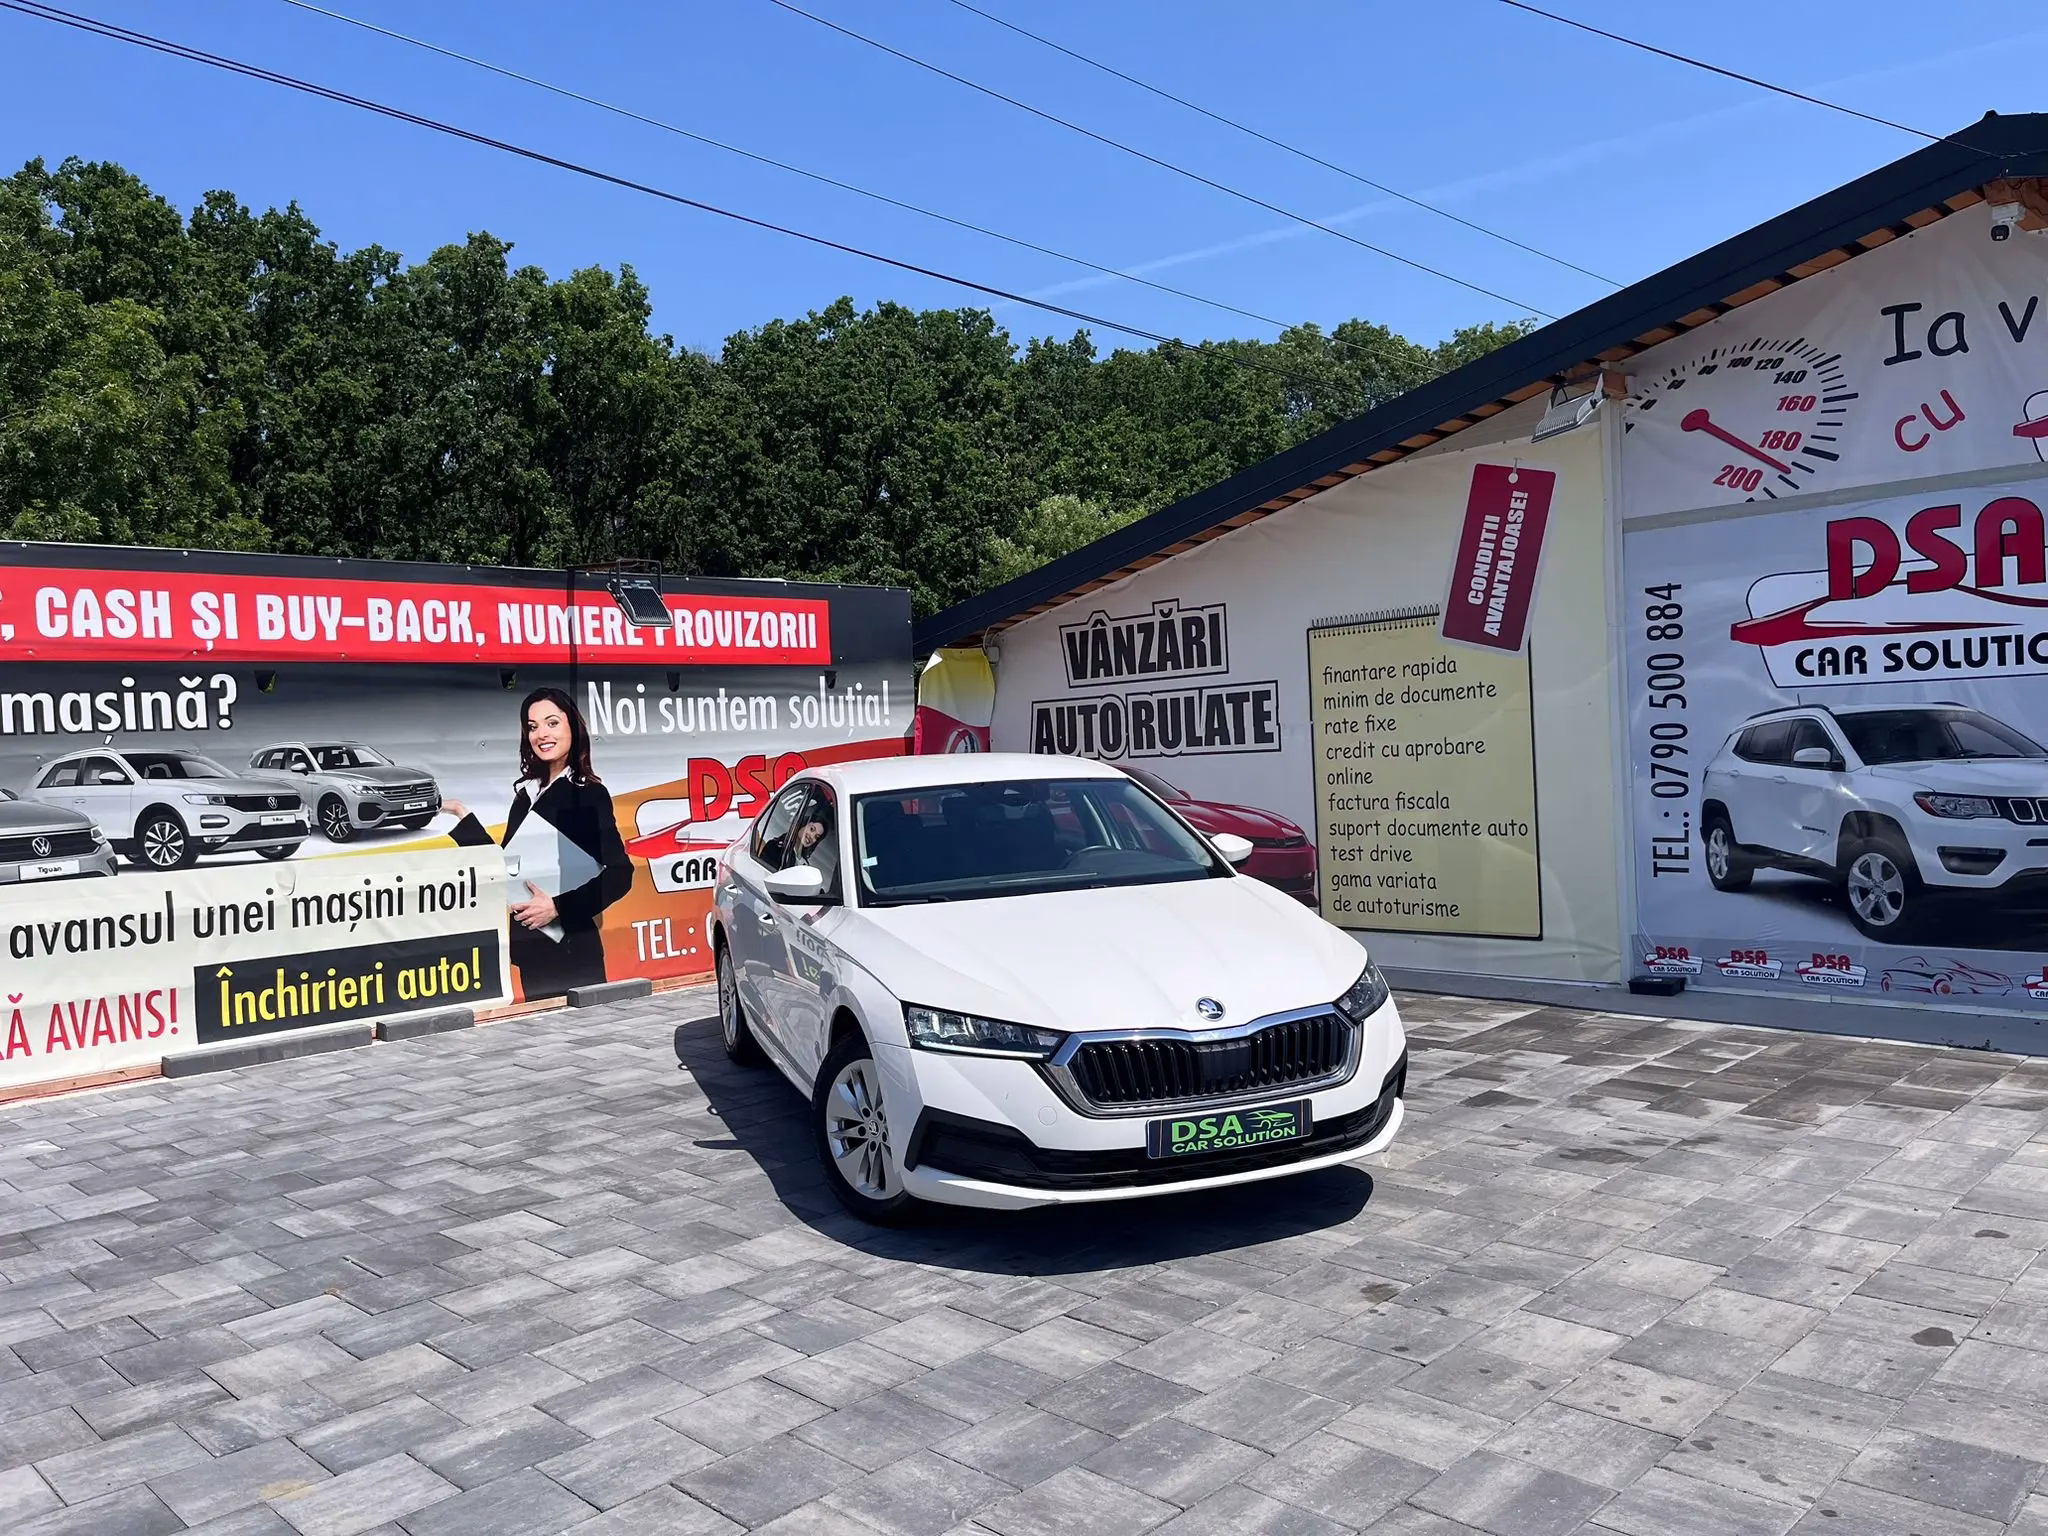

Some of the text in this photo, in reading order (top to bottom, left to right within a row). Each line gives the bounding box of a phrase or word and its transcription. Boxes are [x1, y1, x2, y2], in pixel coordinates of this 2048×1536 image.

[1880, 302, 1969, 366] Ia
[1727, 356, 1753, 368] 100
[1754, 357, 1784, 370] 120
[1773, 370, 1807, 384] 140
[1777, 395, 1816, 412] 160
[1894, 389, 1966, 452] cu
[1759, 430, 1802, 451] 180
[1712, 465, 1763, 492] 200
[1468, 515, 1500, 605] CONDITII
[1827, 497, 2046, 600] DSA
[1483, 491, 1528, 637] AVANTAJOASE!
[35, 586, 173, 639] CASH
[191, 592, 239, 651] ȘI
[256, 594, 485, 647] BUY-BACK,
[1066, 607, 1224, 681] VÂNZĂRI
[1322, 655, 1457, 685] finantare rapida
[1795, 645, 1867, 677] CAR
[586, 675, 890, 738] Noi suntem soluția!
[1323, 681, 1497, 709] minim de documente
[0, 672, 237, 746] mașină?
[1324, 714, 1397, 735] rate fixe
[1645, 582, 1690, 878] TEL.: 0790 500 884
[1326, 736, 1486, 761] credit cu aprobare
[1327, 767, 1373, 785] online
[1328, 790, 1450, 811] factura fiscala
[1329, 818, 1529, 840] suport documente auto
[1330, 844, 1413, 863] test drive
[671, 857, 717, 883] CAR
[1331, 871, 1437, 892] gama variata
[9, 866, 478, 959] avansul unei mașini noi!
[1332, 895, 1460, 917] de autoturisme
[631, 917, 697, 962] TEL.:
[1656, 946, 1689, 960] DSA
[1731, 950, 1767, 965] DSA
[1812, 953, 1850, 971] DSA
[216, 947, 482, 1028] Închirieri auto!
[1741, 970, 1775, 978] SOLUTION
[1822, 976, 1859, 985] SOLUTION
[46, 988, 179, 1054] AVANS!
[1171, 1114, 1244, 1143] DSA
[1171, 1126, 1296, 1154] CAR SOLUTION
